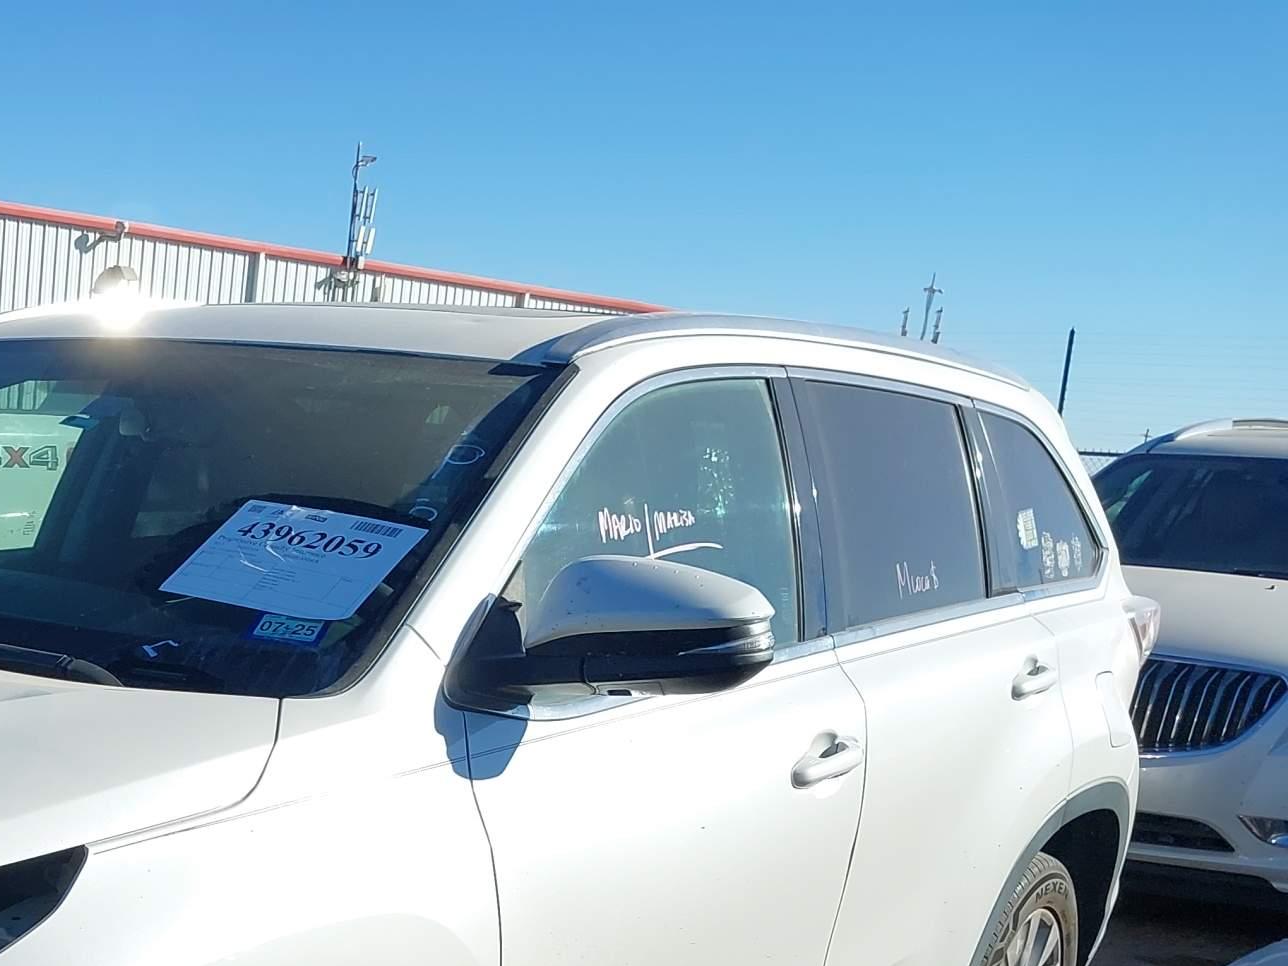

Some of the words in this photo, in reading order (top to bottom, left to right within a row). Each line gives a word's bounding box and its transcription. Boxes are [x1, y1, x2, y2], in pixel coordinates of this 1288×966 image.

[237, 521, 384, 559] 43962059
[259, 620, 286, 633] 07
[291, 623, 318, 637] 25
[1035, 880, 1069, 904] NEXEN
